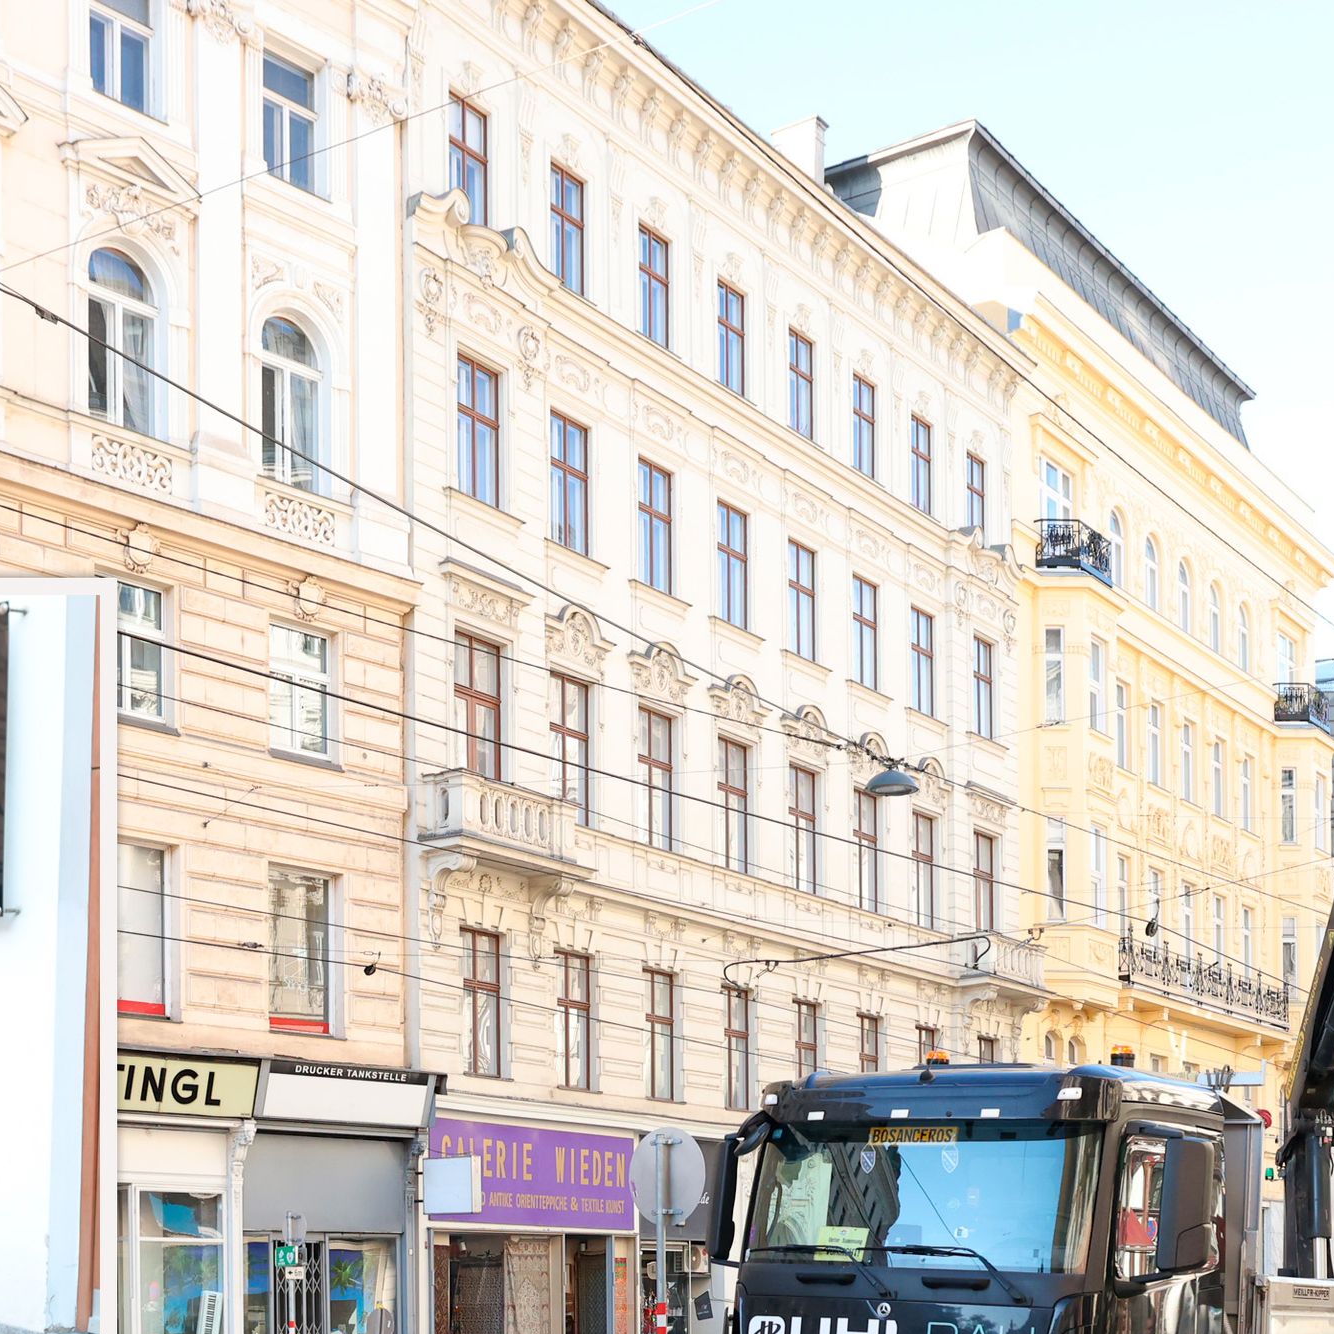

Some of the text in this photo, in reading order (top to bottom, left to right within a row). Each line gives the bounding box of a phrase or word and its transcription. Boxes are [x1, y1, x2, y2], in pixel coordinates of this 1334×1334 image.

[117, 1063, 221, 1106] INGL
[295, 1064, 408, 1083] DRUCKER TANKSTELLE
[872, 1128, 953, 1143] BOSANCEROS
[555, 1146, 626, 1188] WIEDEN
[489, 1192, 625, 1215] ANTIKE ORIENTTEPPICHE & TEXTILE KUNST
